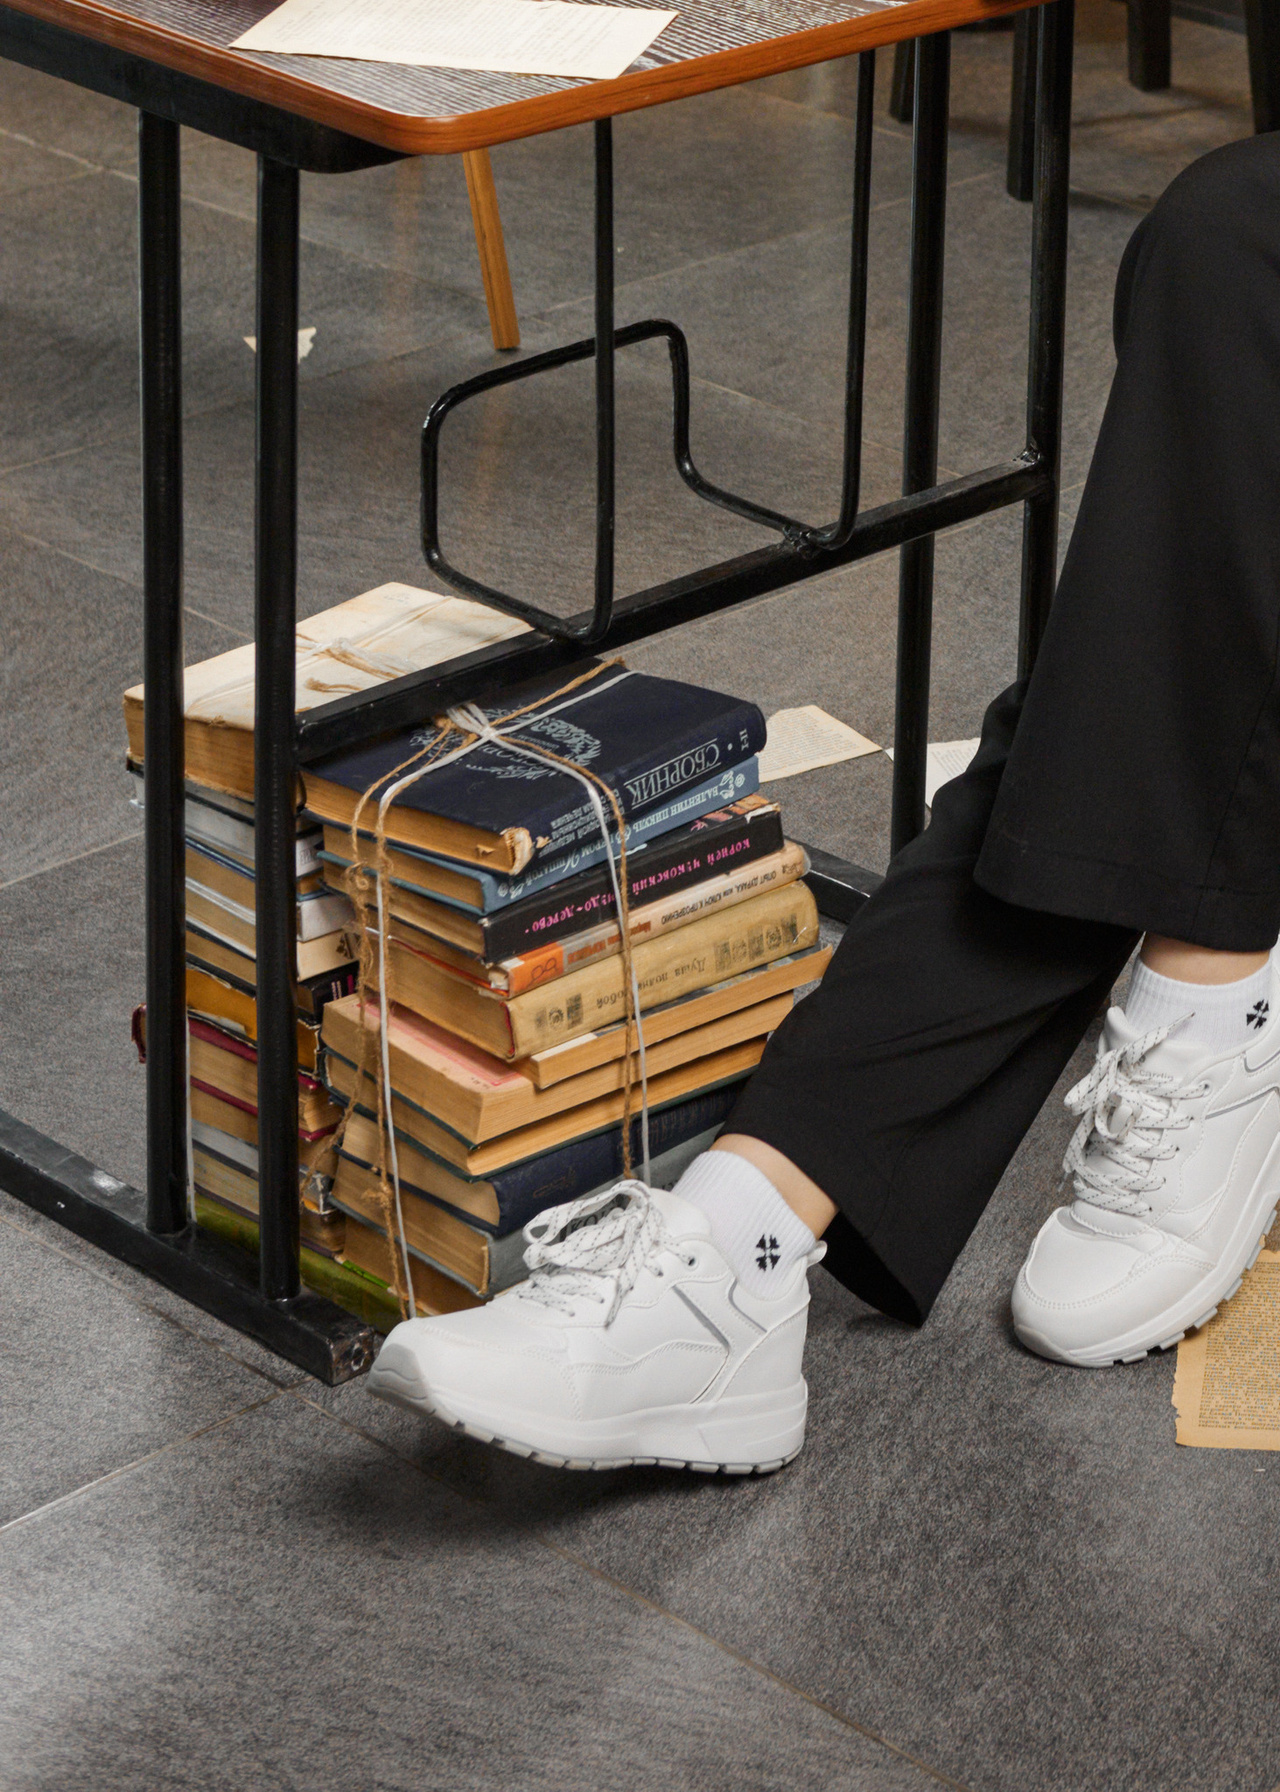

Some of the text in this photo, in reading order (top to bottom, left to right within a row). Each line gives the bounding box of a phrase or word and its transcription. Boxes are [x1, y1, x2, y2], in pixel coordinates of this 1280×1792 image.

[622, 742, 722, 806] СБОРНИК
[669, 784, 720, 813] ВАЛЕНТИН
[632, 804, 670, 835] ПИКУЛЬ
[758, 869, 778, 886] ОПЫТ
[703, 888, 723, 907] КЛЮЧ
[674, 956, 707, 979] Душа
